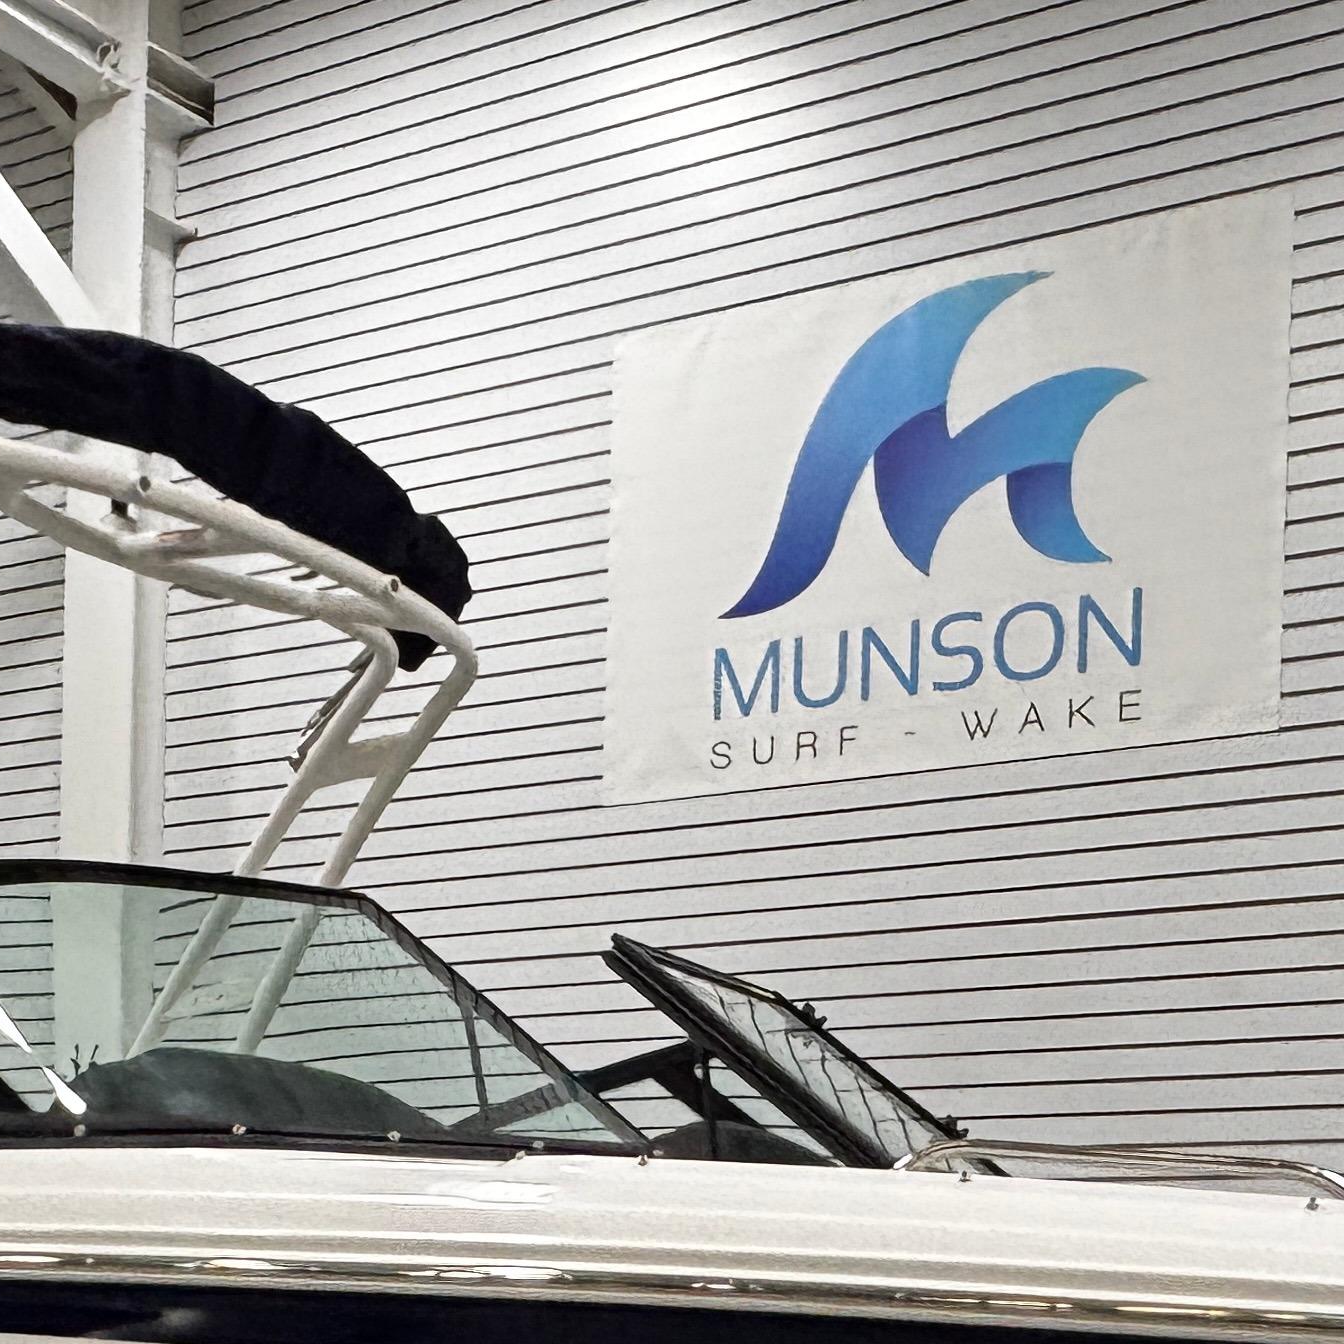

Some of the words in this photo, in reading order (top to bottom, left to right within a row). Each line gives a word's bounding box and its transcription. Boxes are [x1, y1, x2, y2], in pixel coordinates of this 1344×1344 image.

[712, 586, 1144, 721] MUNSON
[709, 724, 859, 770] SURF
[959, 688, 1143, 742] WAKE
